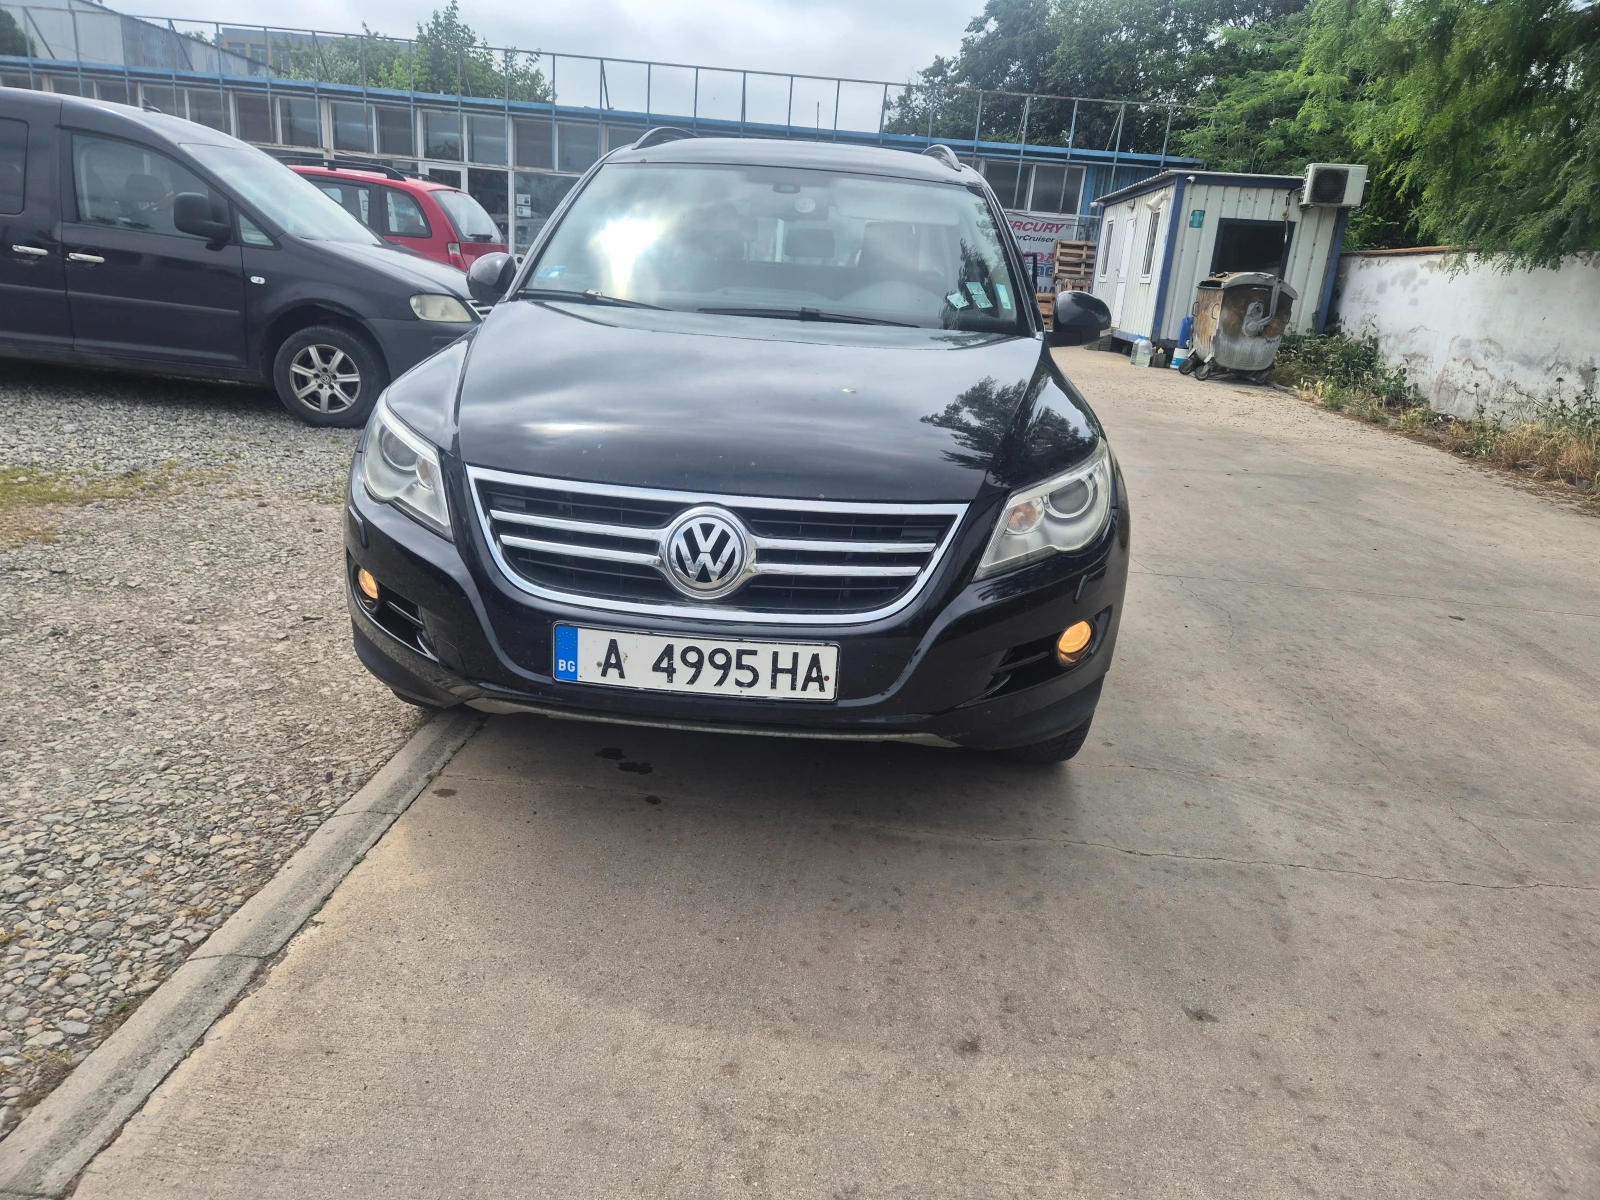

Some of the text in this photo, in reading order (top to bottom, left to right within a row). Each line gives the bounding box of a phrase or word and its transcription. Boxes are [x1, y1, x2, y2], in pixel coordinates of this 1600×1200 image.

[1008, 220, 1065, 234] ERCURY
[1015, 234, 1056, 243] erCruiser
[558, 659, 576, 673] BG
[600, 638, 826, 693] A 4995 HA
